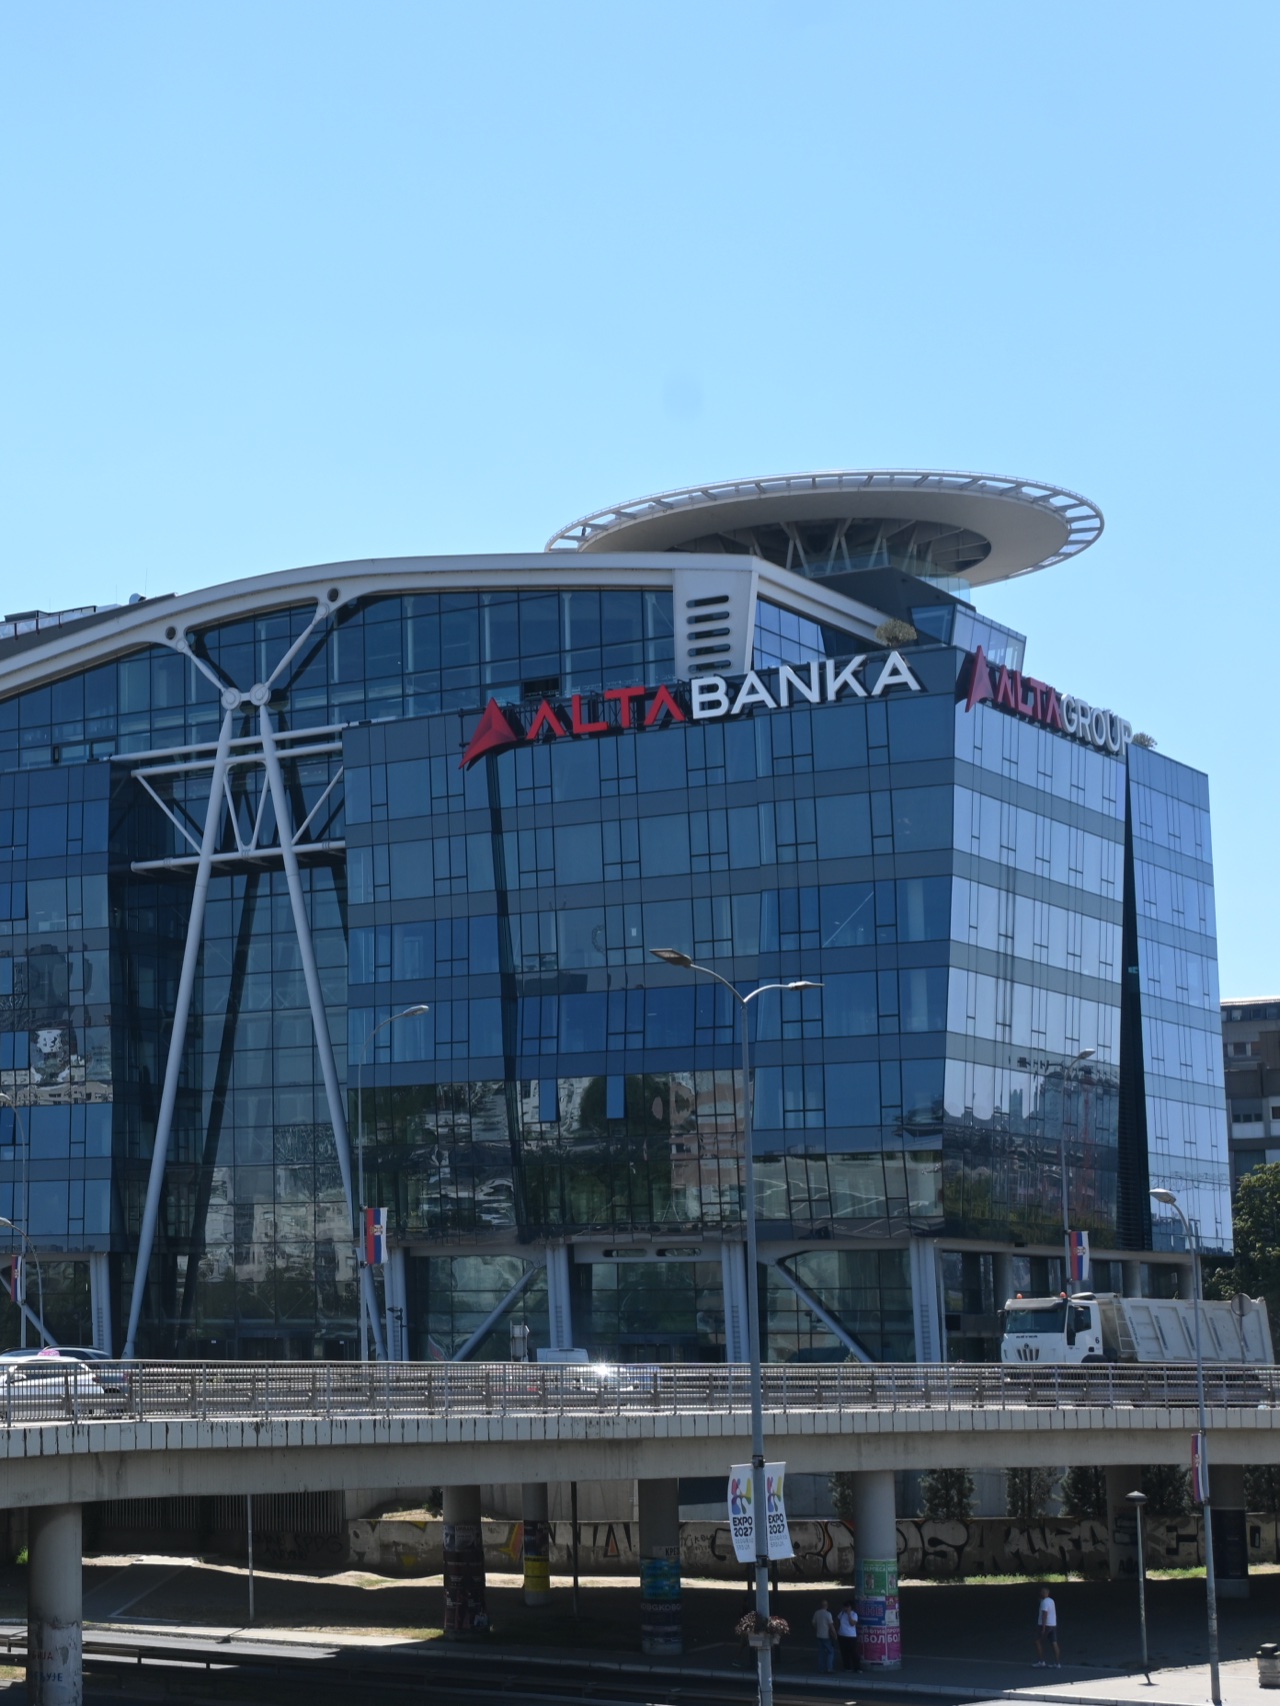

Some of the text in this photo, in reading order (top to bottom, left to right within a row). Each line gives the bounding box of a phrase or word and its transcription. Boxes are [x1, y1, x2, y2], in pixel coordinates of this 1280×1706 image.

[733, 1516, 753, 1527] EXPO
[768, 1513, 784, 1524] EXPO
[734, 1527, 753, 1537] 2027
[769, 1524, 785, 1534] 2027
